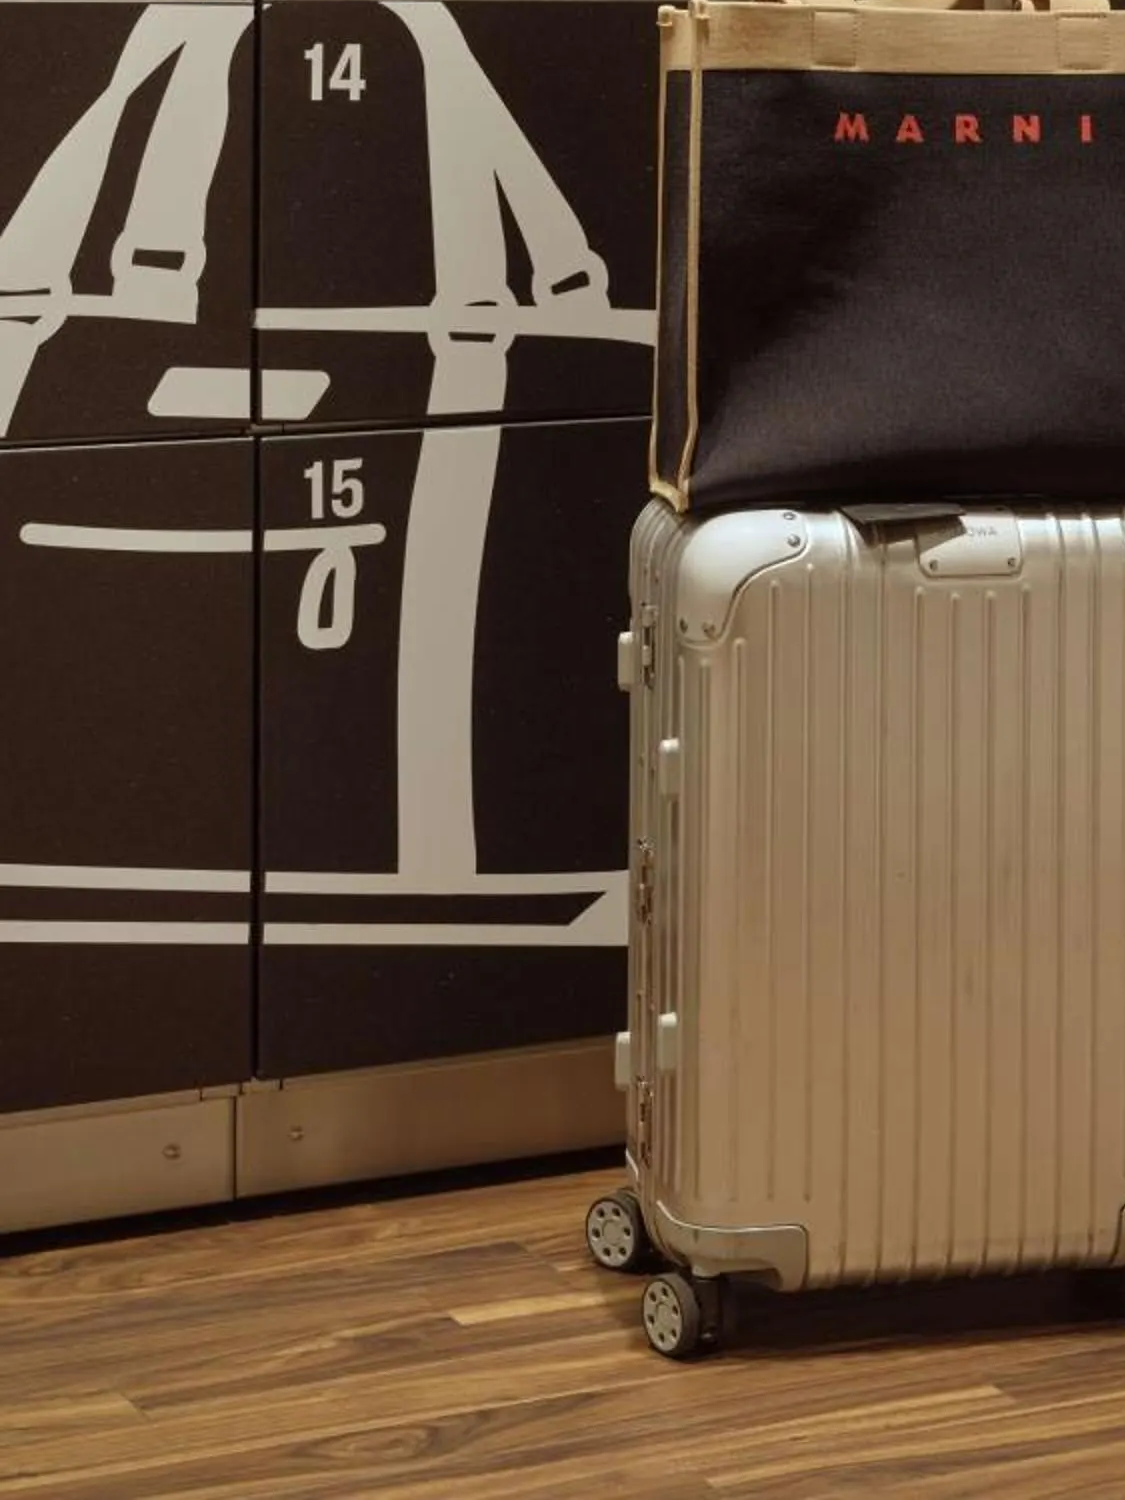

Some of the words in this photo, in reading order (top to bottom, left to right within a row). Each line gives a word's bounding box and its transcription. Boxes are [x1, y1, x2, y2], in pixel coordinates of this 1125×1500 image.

[304, 43, 366, 101] 14
[835, 114, 1091, 142] MARNI
[303, 457, 364, 519] 15
